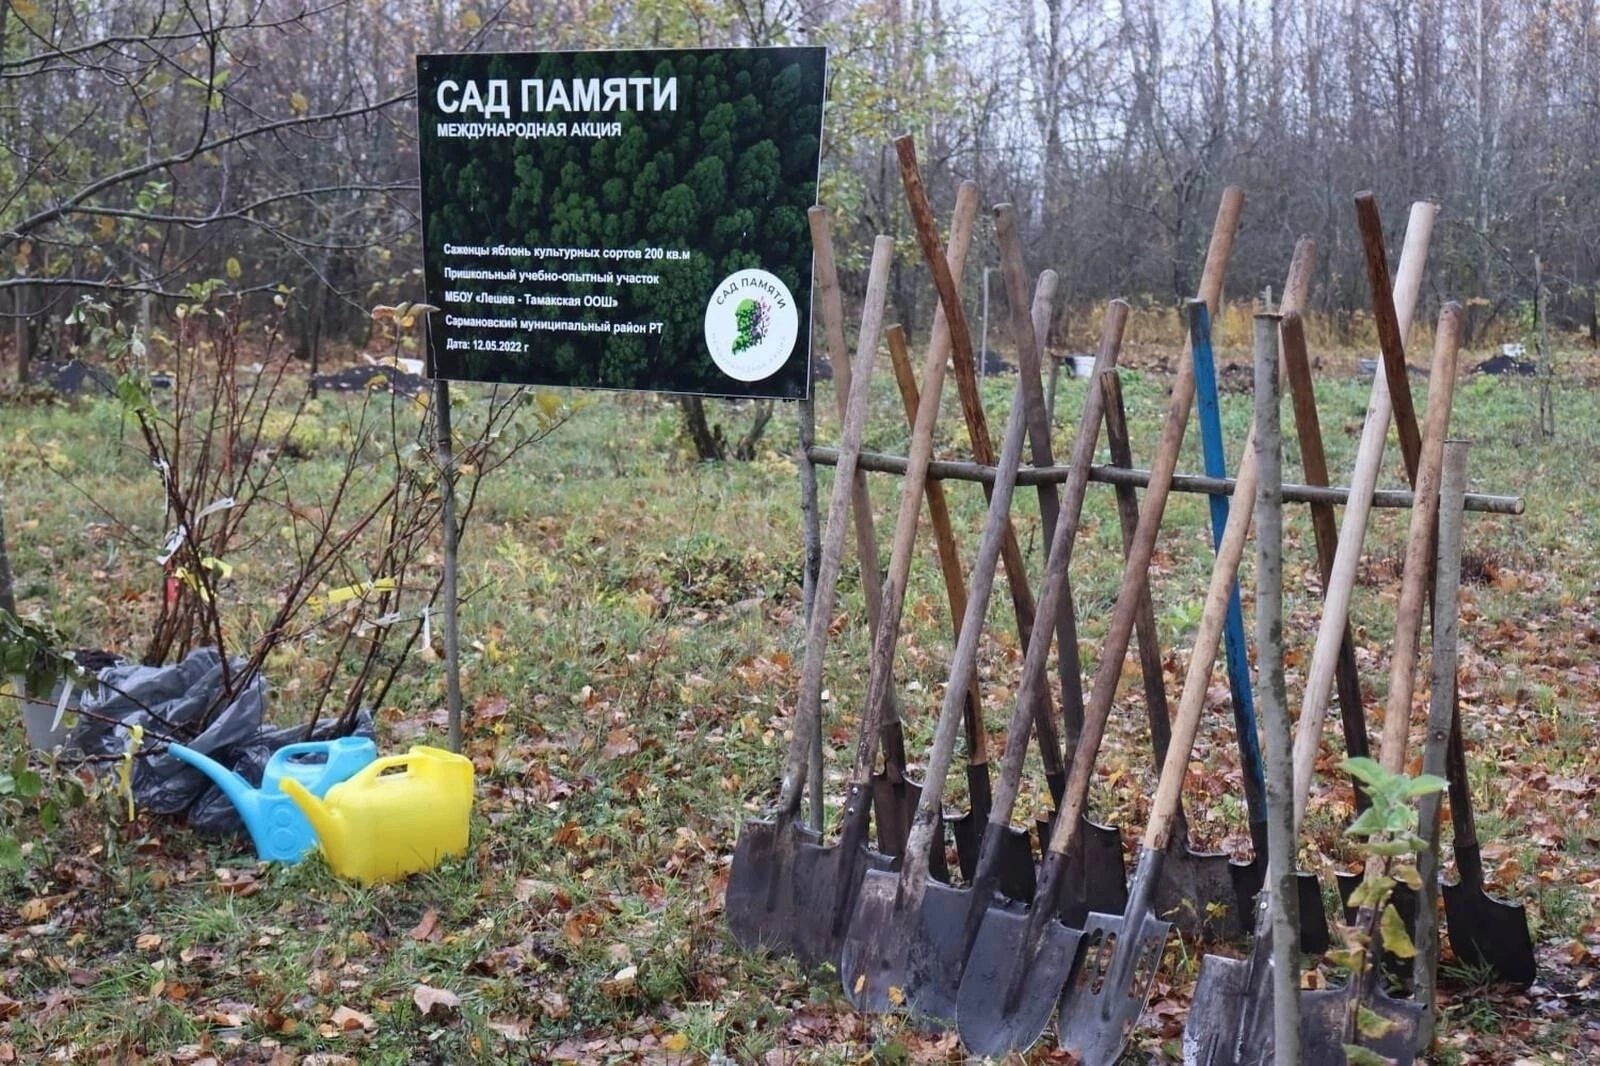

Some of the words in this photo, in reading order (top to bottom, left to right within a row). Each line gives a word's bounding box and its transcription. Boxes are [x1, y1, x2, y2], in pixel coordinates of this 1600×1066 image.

[437, 79, 511, 119] САД
[520, 77, 677, 112] ПАМЯТИ
[437, 122, 567, 139] МЕЖДУНАРОДНАЯ
[570, 122, 622, 139] АКЦИЯ
[443, 243, 490, 257] Саженцы
[491, 245, 532, 257] яблонь
[533, 247, 600, 260] культурных
[602, 248, 642, 261] сортов
[644, 247, 664, 259] 200
[666, 250, 691, 260] кв.м
[444, 267, 517, 281] Пришкольный
[519, 269, 614, 283] учебно-опытный
[616, 273, 660, 286] участок
[445, 291, 473, 303] МБОУ
[524, 293, 581, 307] Тамакская
[583, 295, 619, 308] ООШ»
[716, 282, 739, 305] САД
[741, 277, 786, 310] ПАМЯТИ
[445, 314, 518, 329] Сармановский
[520, 320, 611, 332] муниципальный
[613, 321, 647, 335] район
[649, 322, 664, 334] РТ
[446, 338, 471, 350] Дата:
[473, 339, 522, 352] 12.05.2022
